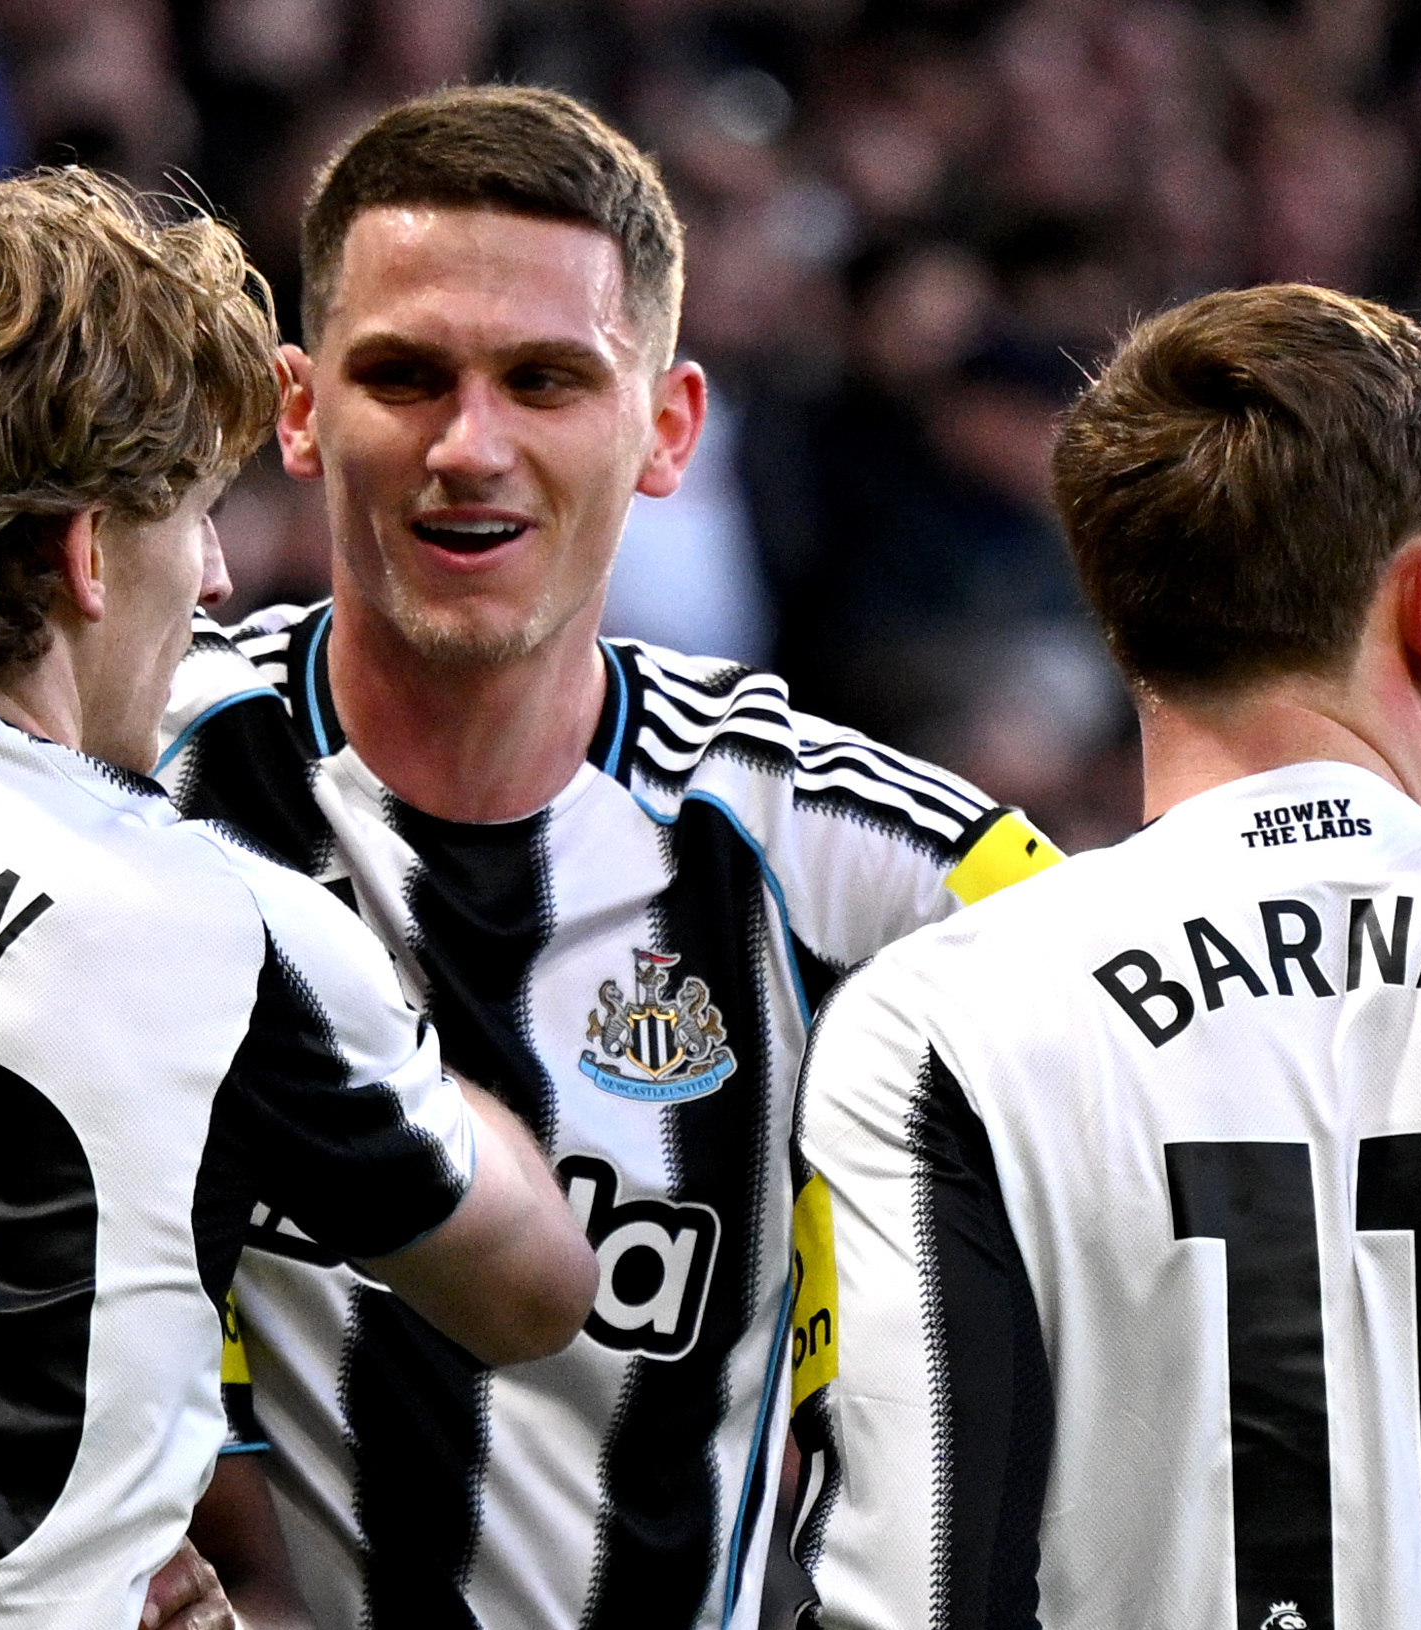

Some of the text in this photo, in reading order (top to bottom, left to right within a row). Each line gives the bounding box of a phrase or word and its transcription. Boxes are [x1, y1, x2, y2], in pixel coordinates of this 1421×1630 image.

[1253, 799, 1351, 829] HOWAY
[1240, 818, 1372, 848] THE LADS
[599, 1076, 714, 1097] NEWCASTLE UNITED
